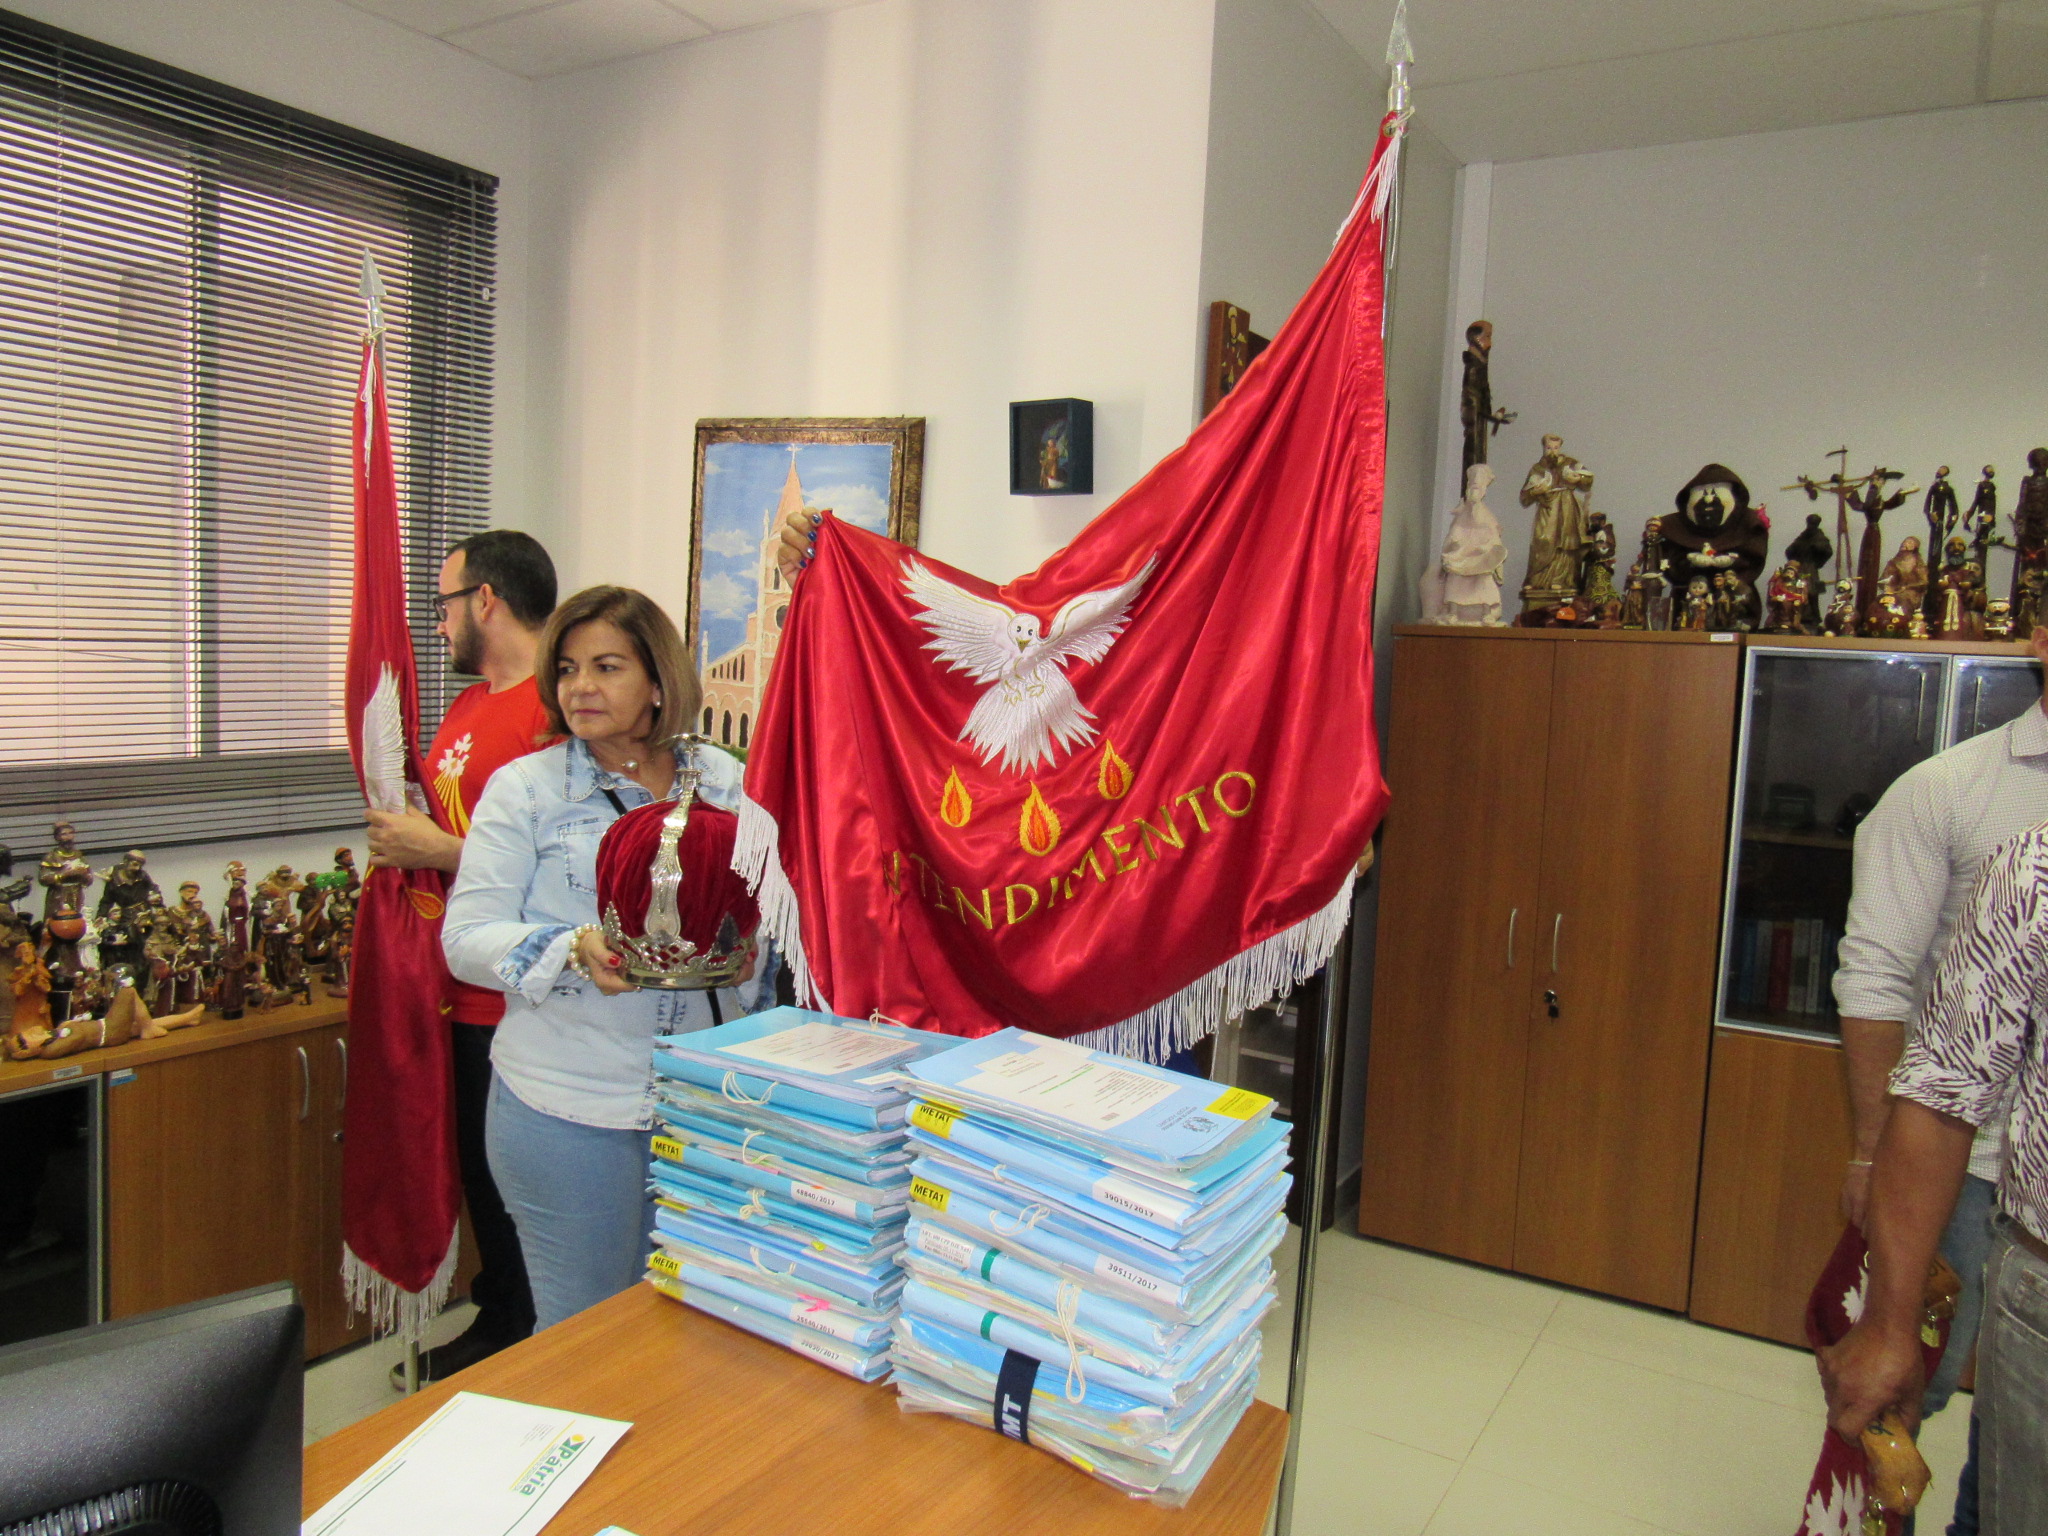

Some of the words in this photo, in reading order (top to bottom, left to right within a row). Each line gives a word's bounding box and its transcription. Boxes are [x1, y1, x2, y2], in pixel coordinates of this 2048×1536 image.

[882, 770, 1256, 930] NTENDIMENTO
[655, 1140, 680, 1156] META1
[914, 1184, 944, 1203] META1
[1104, 1191, 1154, 1218] 39015/2017
[653, 1255, 679, 1271] META1
[1107, 1262, 1158, 1291] 39511/2017
[519, 1446, 575, 1496] Pátria
